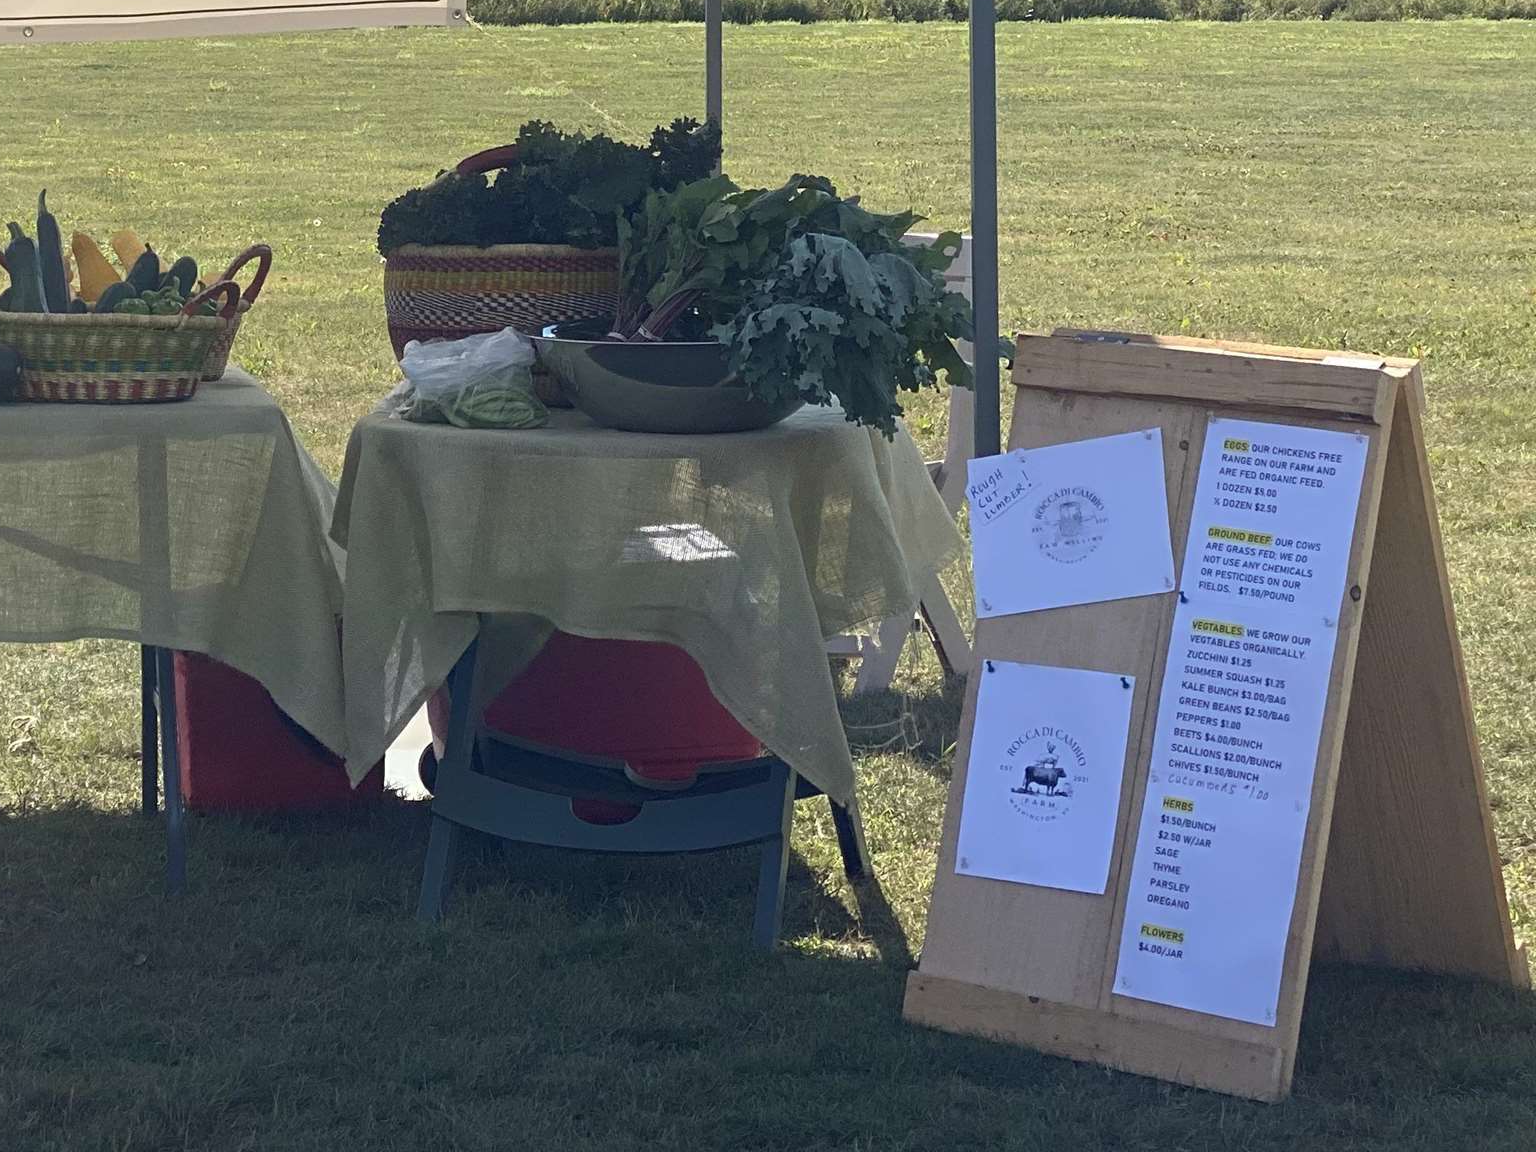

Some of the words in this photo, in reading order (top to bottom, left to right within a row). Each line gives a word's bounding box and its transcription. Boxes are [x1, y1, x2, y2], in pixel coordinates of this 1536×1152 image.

[1251, 444, 1270, 453] OUR
[1272, 447, 1316, 460] CHICKENS
[1319, 452, 1343, 463] FREE
[1221, 454, 1252, 465] RANGE
[1254, 458, 1267, 467] ON
[1269, 460, 1288, 469] OUR
[1290, 462, 1314, 473] FARM
[1316, 466, 1336, 476] AND
[1219, 467, 1238, 477] ARE
[1239, 470, 1257, 480] FED
[1259, 472, 1297, 484] ORGANIC
[1299, 478, 1325, 489] FEED.
[1222, 483, 1252, 495] DOZEN
[978, 489, 999, 509] CUT
[1222, 498, 1252, 510] DOZEN
[1254, 503, 1277, 514] $2.50
[1208, 528, 1246, 541] GROUND
[1275, 538, 1293, 548] OUR
[1295, 540, 1321, 551] COWS
[1205, 542, 1224, 552] ARE
[1226, 545, 1256, 556] GRASS
[1279, 552, 1293, 562] WE
[1295, 554, 1308, 563] DO
[1203, 555, 1221, 565] NOT
[1223, 557, 1241, 567] USE
[1242, 560, 1261, 570] ANY
[1262, 563, 1313, 578] CHEMICALS
[1201, 567, 1213, 577] OR
[1215, 569, 1265, 584] PESTICIDES
[1267, 577, 1280, 587] ON
[1282, 579, 1301, 589] OUR
[1238, 586, 1295, 602] $7.50/POUND
[1190, 635, 1241, 650] VEGTABLES
[1247, 629, 1260, 638] WE
[1262, 632, 1289, 643] GROW
[1291, 635, 1311, 646] OUR
[1186, 649, 1229, 664] ZUCCHINI
[1231, 656, 1252, 667] $1.25
[1184, 665, 1223, 679] SUMMER
[1226, 672, 1262, 685] SQUASH
[1264, 678, 1285, 689] $1.25
[1181, 681, 1205, 693] KALE
[1207, 686, 1239, 697] BUNCH
[1241, 690, 1287, 705] $3.00/BAG
[1179, 696, 1210, 708] GREEN
[1212, 702, 1242, 714] BEANS
[1244, 707, 1291, 722] $2.50/BAG
[1176, 712, 1218, 727] PEPPERS
[1220, 719, 1241, 730] $1.00
[1042, 726, 1054, 737] DI
[1174, 728, 1202, 740] BEETS
[1205, 733, 1263, 750] $4.00/BUNCH
[1170, 743, 1222, 760] SCALLIONS
[1223, 752, 1282, 769] $2.00/BUNCH
[1168, 759, 1205, 773] CHIVES
[1203, 764, 1259, 782] $1.50/BUNCH
[1163, 798, 1194, 812] HERBS
[1160, 814, 1216, 832] $1.50/BUNCH
[1158, 830, 1181, 843] $2.50
[1183, 837, 1212, 848] W/JAR
[1154, 847, 1179, 858] SAGE
[1153, 862, 1181, 875] THYME
[1150, 878, 1190, 893] PARSLEY
[1147, 894, 1190, 910] OREGANO
[1140, 925, 1184, 942] FLOWERS
[1138, 942, 1183, 958] $4.00/JAR
